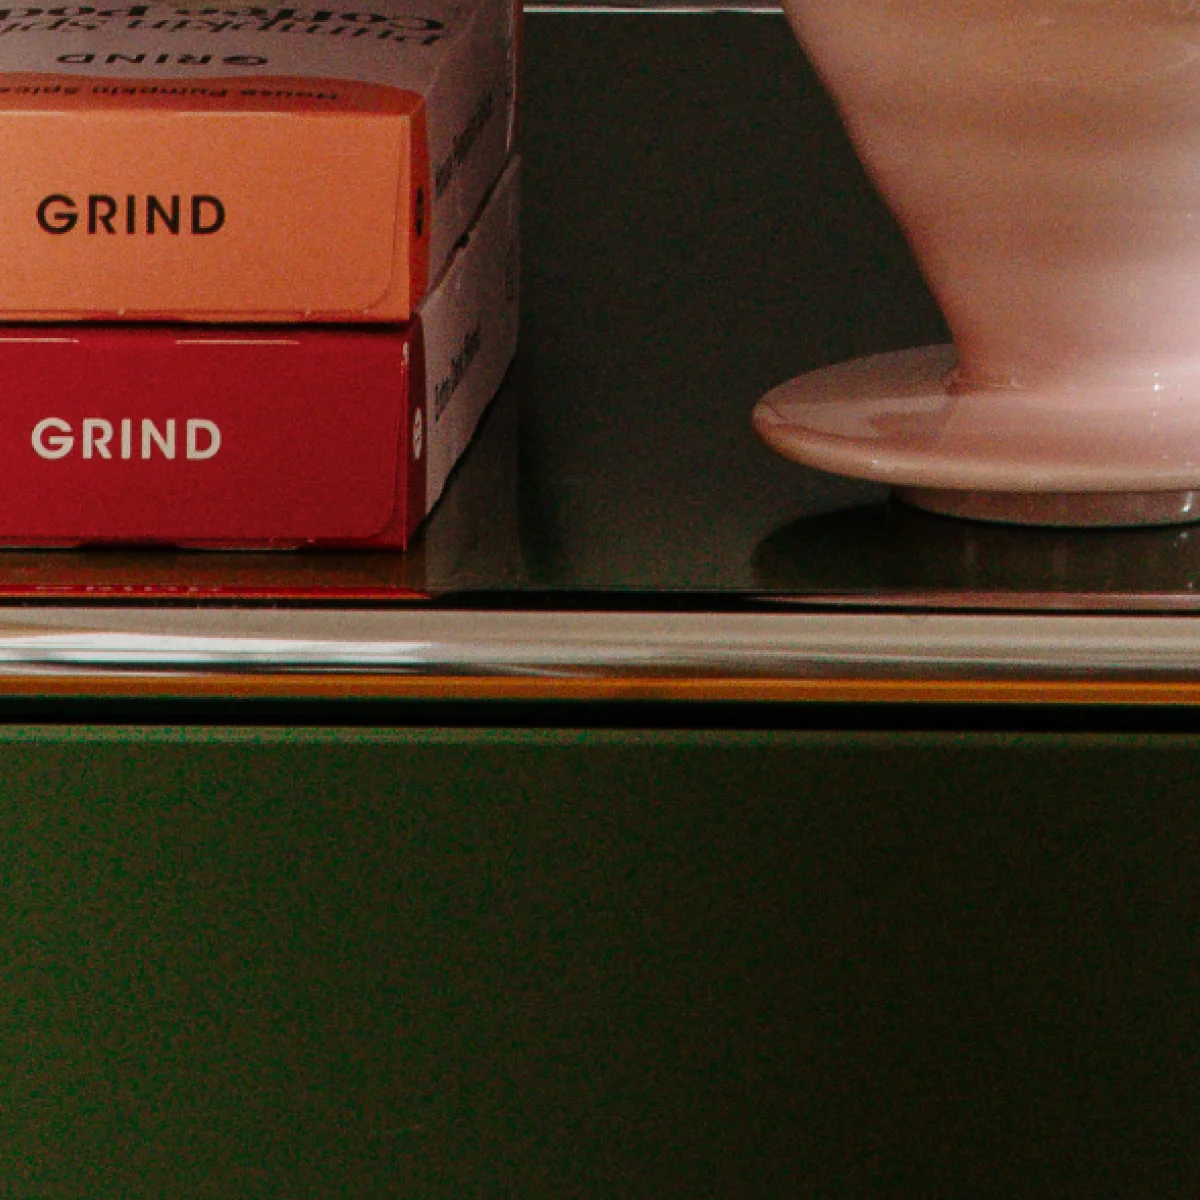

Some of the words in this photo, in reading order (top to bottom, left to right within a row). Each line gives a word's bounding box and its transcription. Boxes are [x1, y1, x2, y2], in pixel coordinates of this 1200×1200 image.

[57, 53, 268, 66] GRIND
[36, 194, 227, 235] GRIND
[31, 417, 222, 460] GRIND
